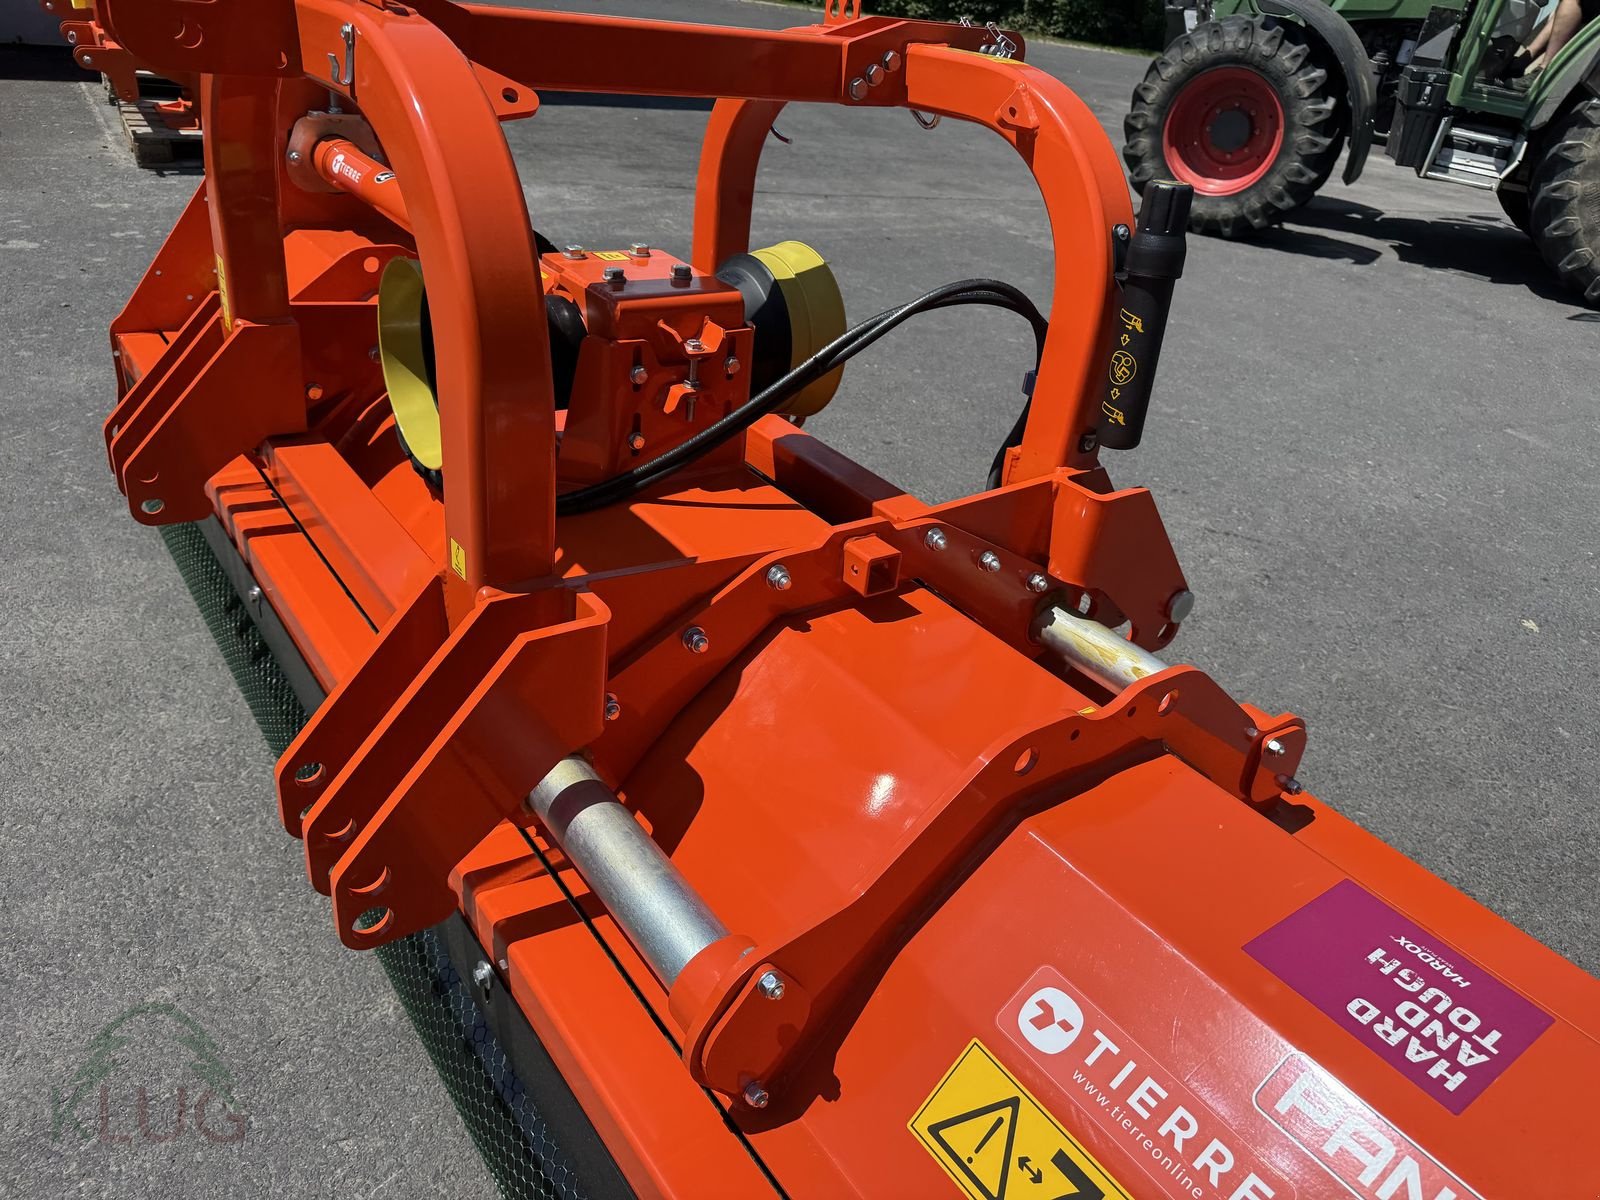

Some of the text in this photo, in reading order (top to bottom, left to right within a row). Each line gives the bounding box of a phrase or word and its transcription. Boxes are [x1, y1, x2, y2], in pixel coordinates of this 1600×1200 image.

[340, 161, 361, 183] TIERRE
[1364, 948, 1503, 1054] TOUGH
[1392, 936, 1472, 988] HARDOX
[1346, 998, 1468, 1092] HARD
[1395, 1000, 1490, 1067] AND
[1072, 1069, 1203, 1199] www.tierreonline
[1084, 1029, 1276, 1200] TIERRE
